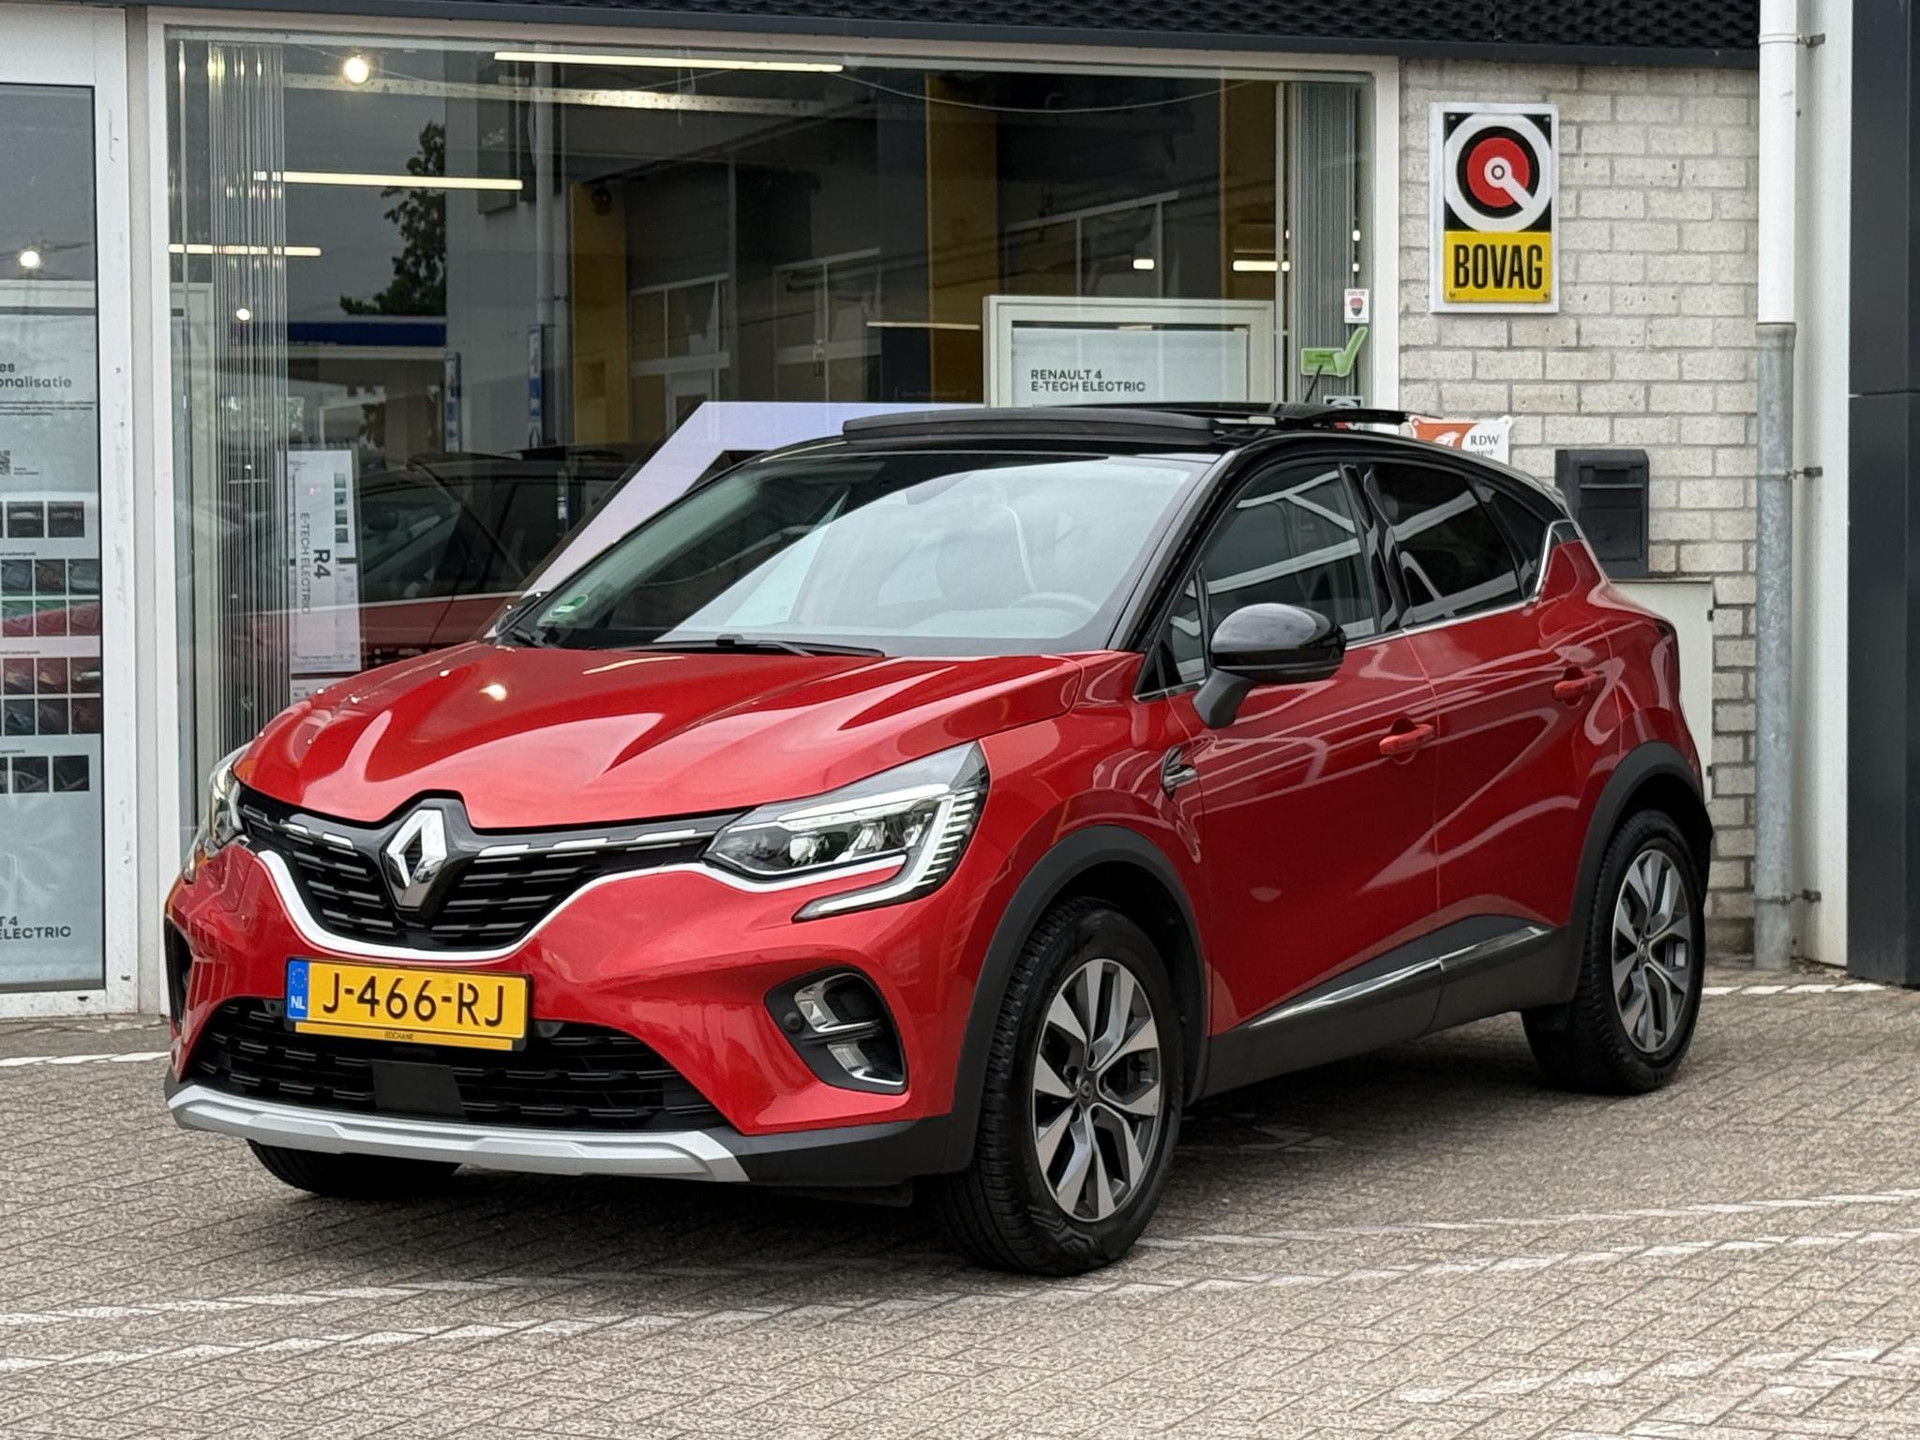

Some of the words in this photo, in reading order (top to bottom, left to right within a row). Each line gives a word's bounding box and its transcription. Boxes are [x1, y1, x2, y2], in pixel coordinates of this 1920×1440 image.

[1453, 243, 1543, 290] BOVAG
[1030, 369, 1092, 380] RENAULT
[1094, 369, 1102, 380] 4
[1031, 381, 1079, 392] E-TECH
[1082, 381, 1146, 392] ELECTRIC
[1470, 434, 1500, 446] RDW
[300, 512, 311, 556] E-TECH
[313, 549, 331, 579] R4
[8, 915, 18, 926] 4
[0, 925, 72, 940] LECTRIC
[290, 995, 306, 1010] NL
[322, 972, 504, 1028] J-466-RJ
